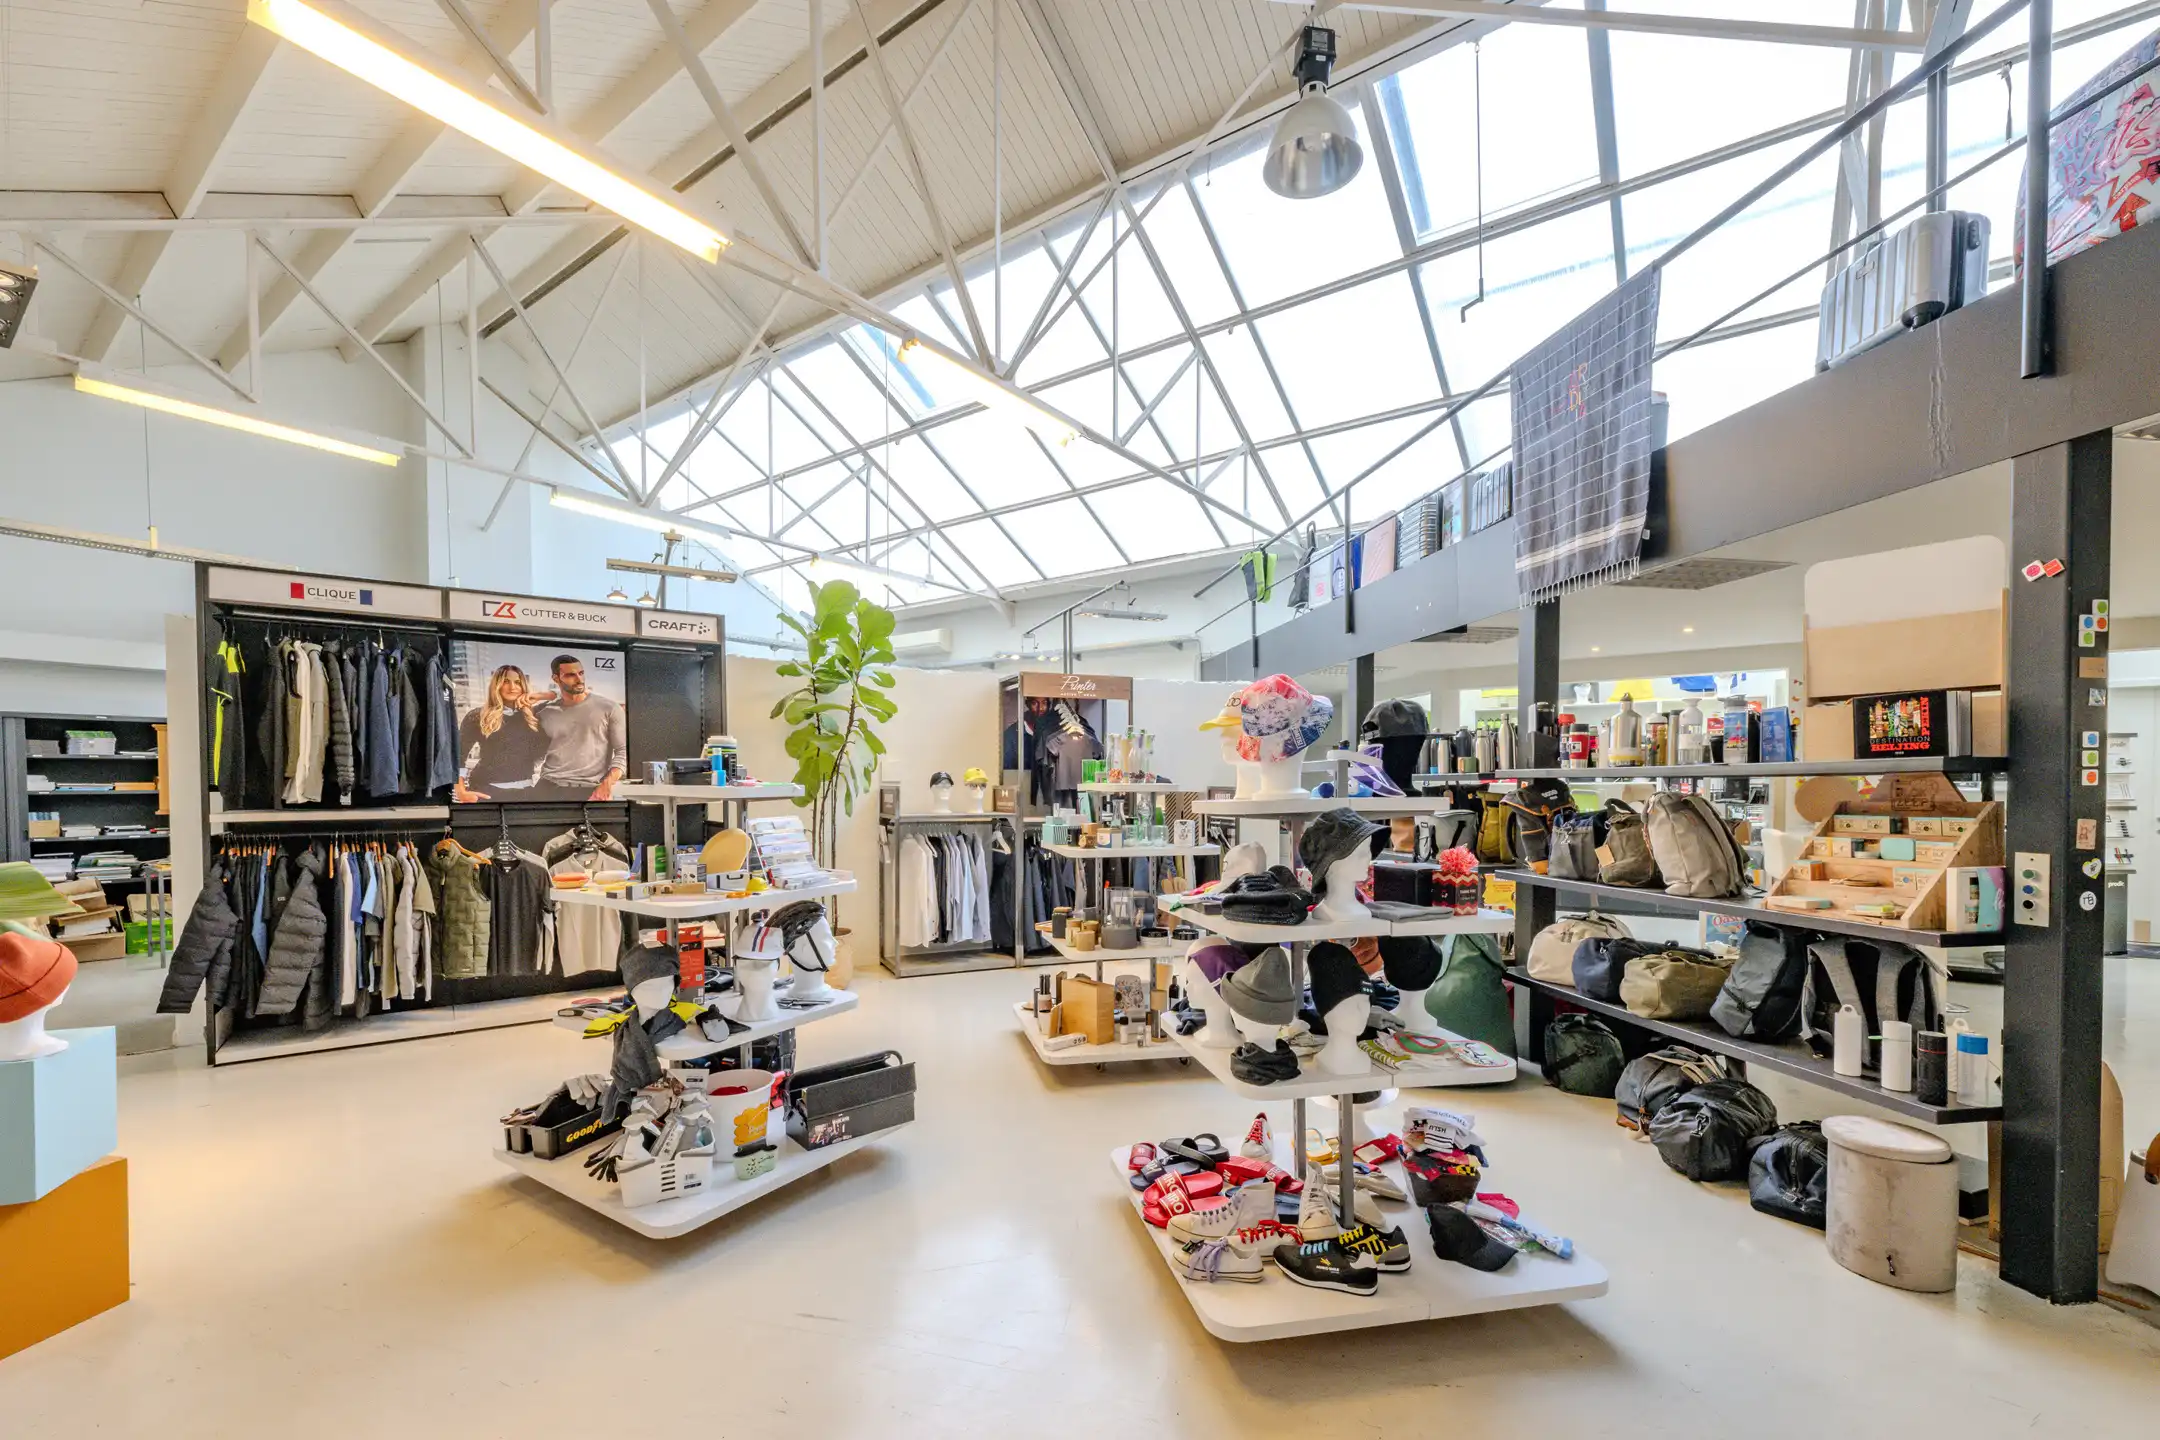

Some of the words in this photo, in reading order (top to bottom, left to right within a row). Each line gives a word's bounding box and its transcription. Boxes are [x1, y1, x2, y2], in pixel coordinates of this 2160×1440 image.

[307, 587, 357, 600] CLIQUE
[521, 607, 566, 620] CUTTER
[568, 612, 575, 620] &
[577, 613, 607, 623] BUCK
[648, 619, 697, 633] CRAFT
[1060, 675, 1097, 692] Printer
[1869, 735, 1931, 745] DESTINATION
